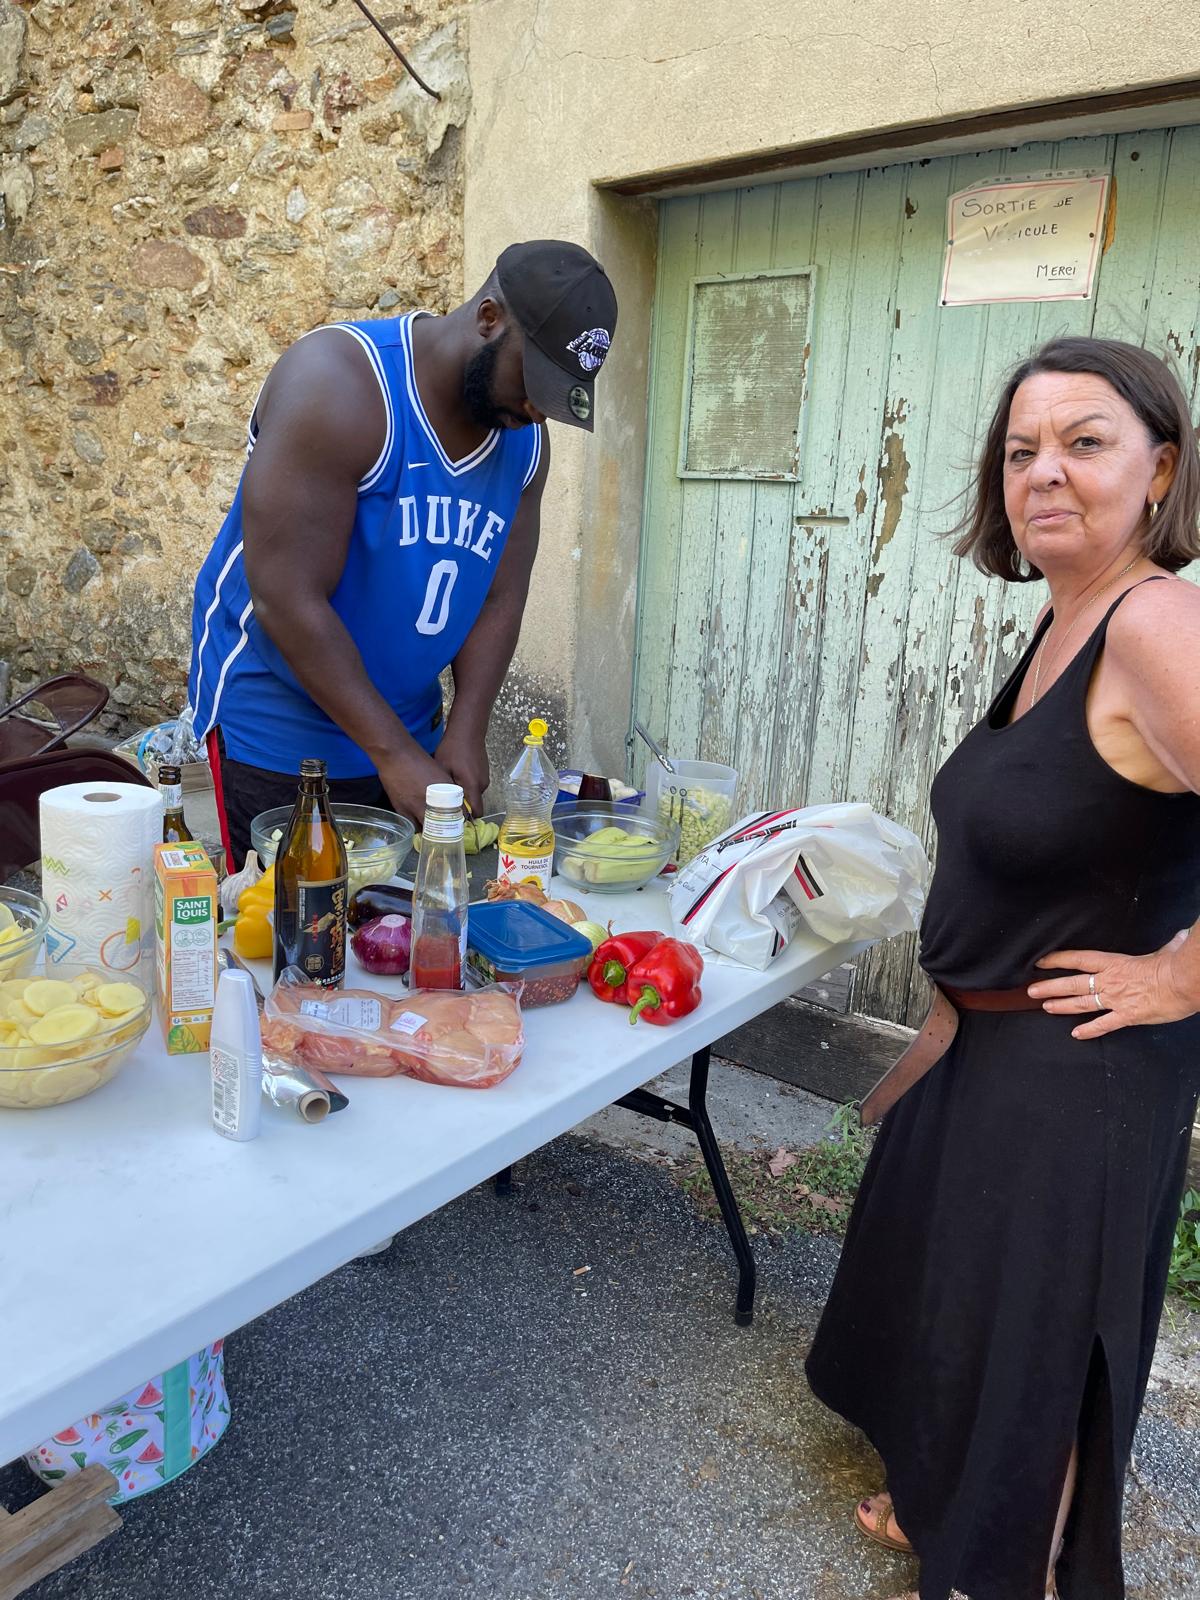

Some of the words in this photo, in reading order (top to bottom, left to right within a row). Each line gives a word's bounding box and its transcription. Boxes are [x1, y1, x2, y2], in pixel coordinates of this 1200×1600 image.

[399, 495, 506, 560] DUKE
[415, 559, 459, 636] 0
[176, 900, 209, 910] SAINT
[177, 908, 209, 920] LOUIS
